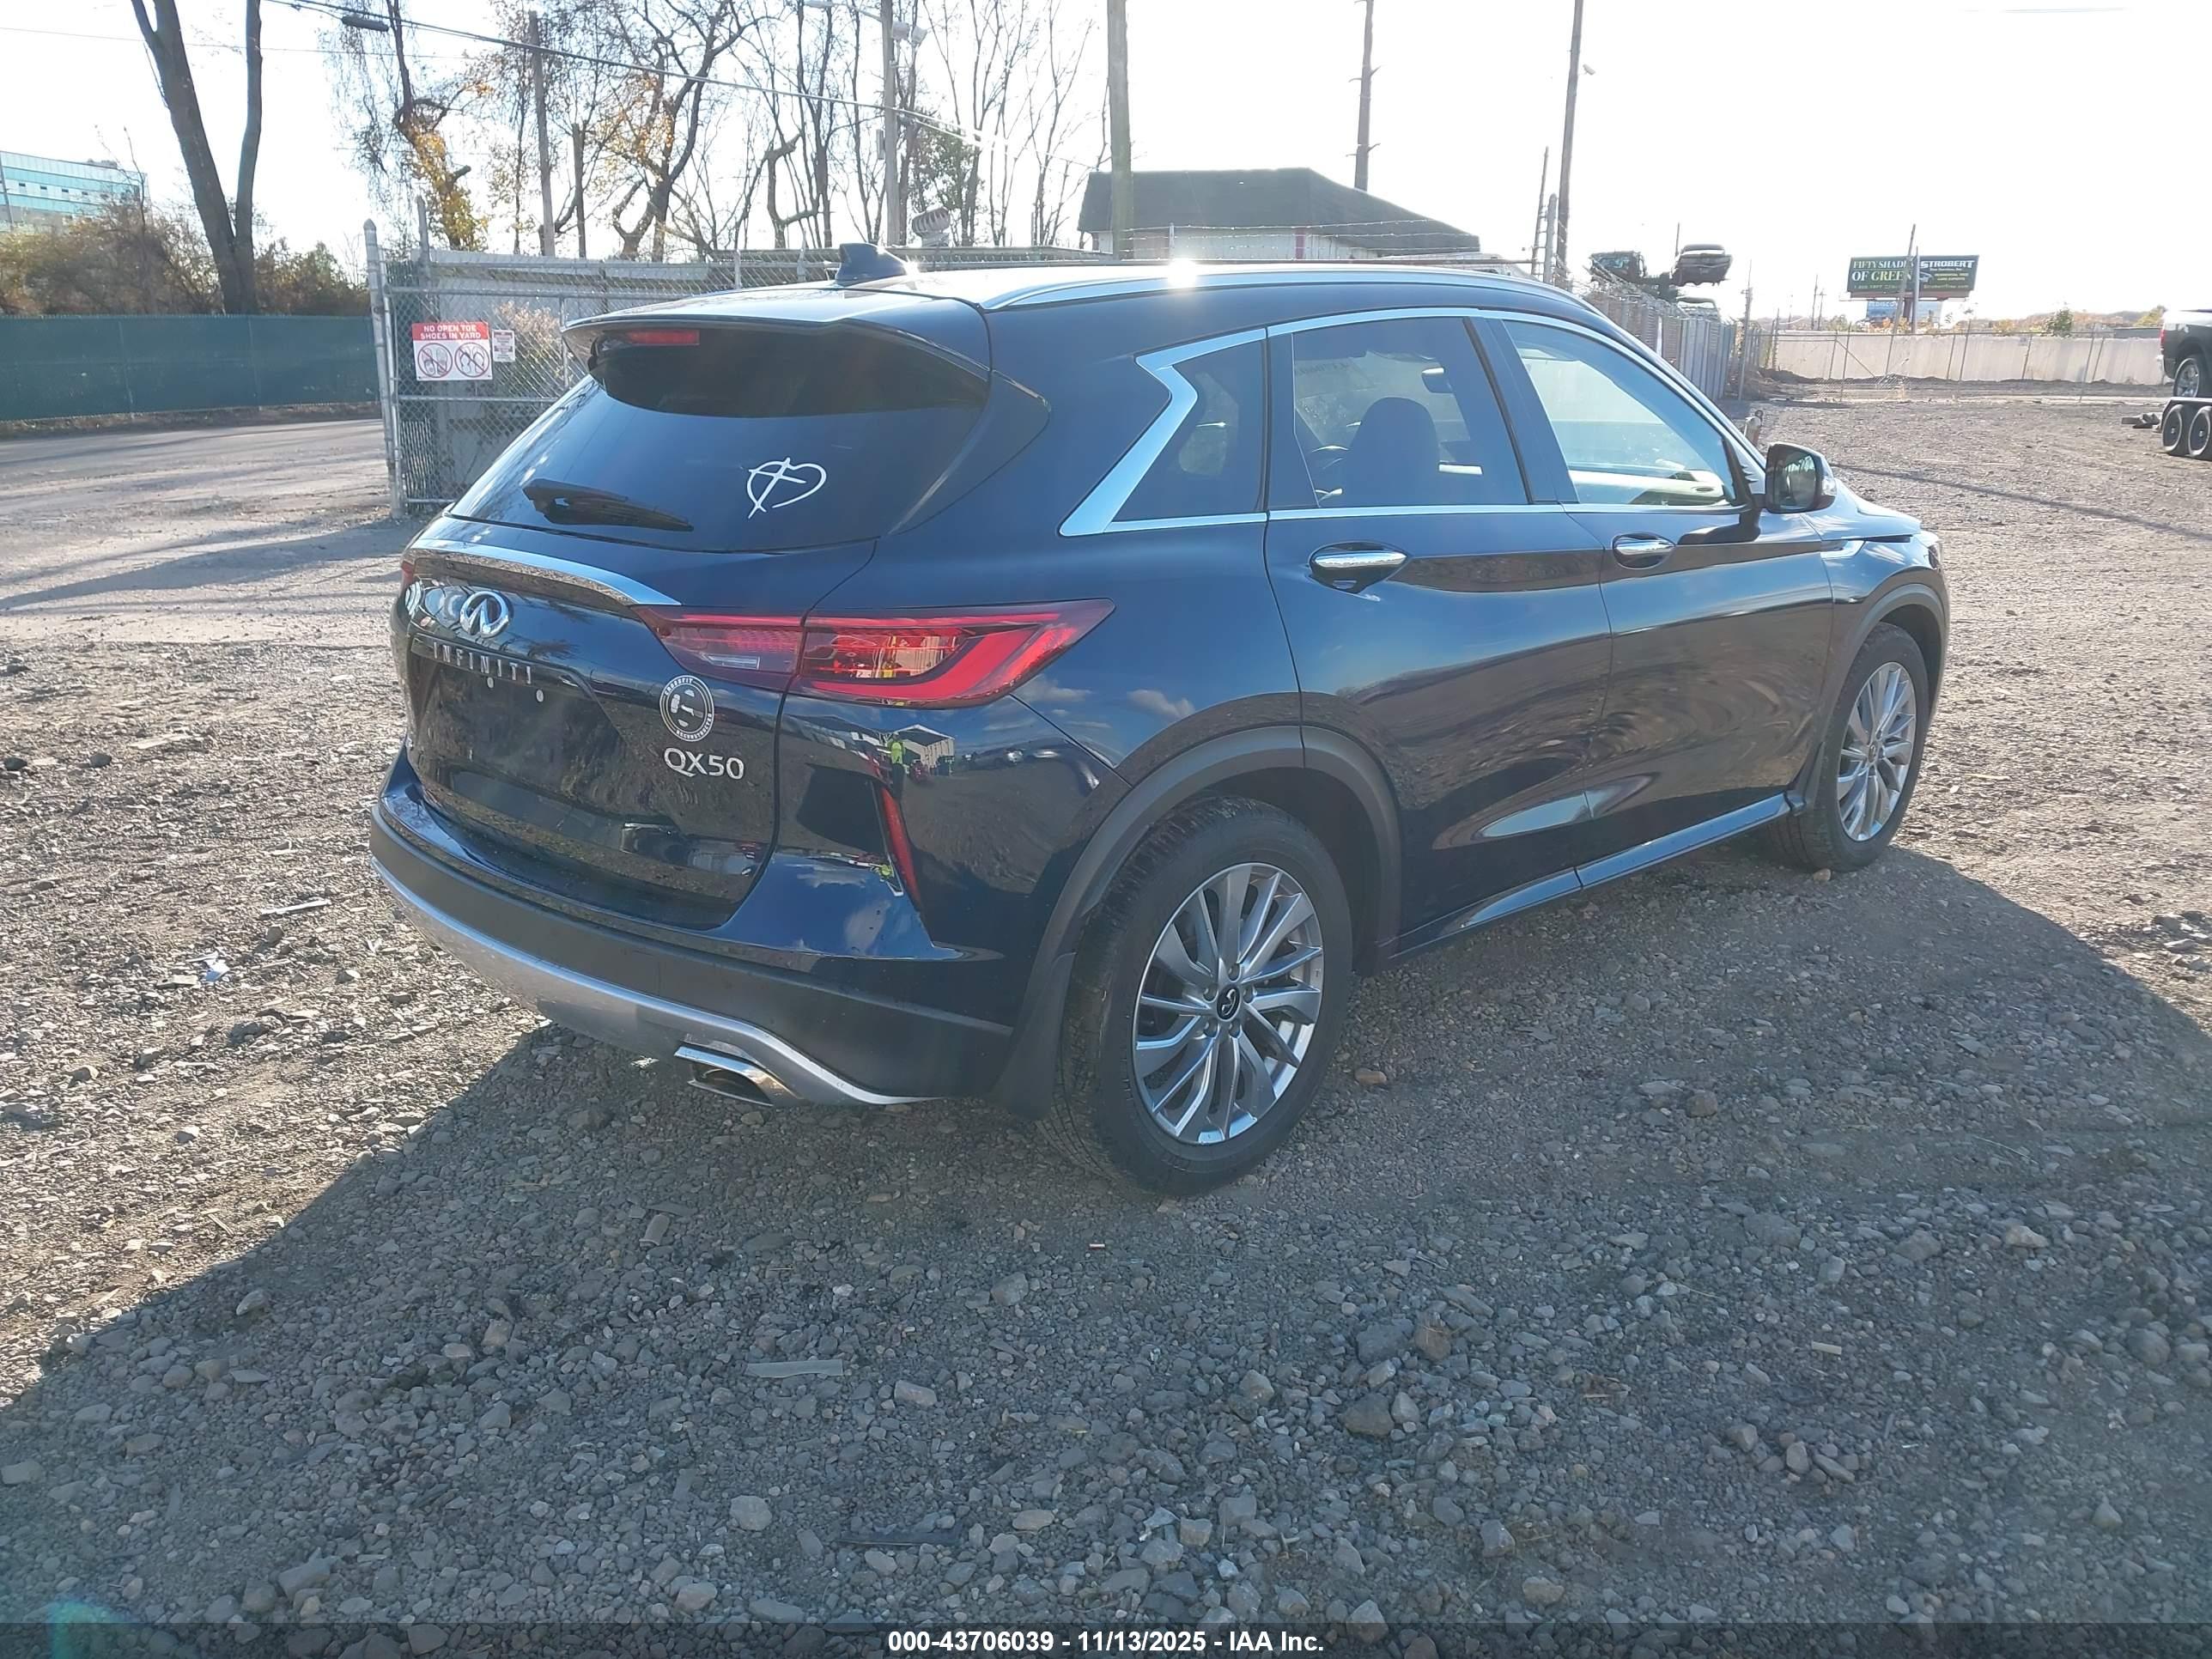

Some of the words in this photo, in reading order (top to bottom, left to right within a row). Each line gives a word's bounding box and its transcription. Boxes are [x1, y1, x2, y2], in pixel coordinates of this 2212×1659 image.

[1853, 260, 1878, 269] FIFTY
[1920, 259, 1975, 269] STROBERT
[1851, 270, 1869, 282] OF
[459, 324, 477, 332] TOE
[433, 641, 532, 684] INFINITI
[664, 678, 694, 696] CROSSFIT
[664, 747, 744, 780] QX50
